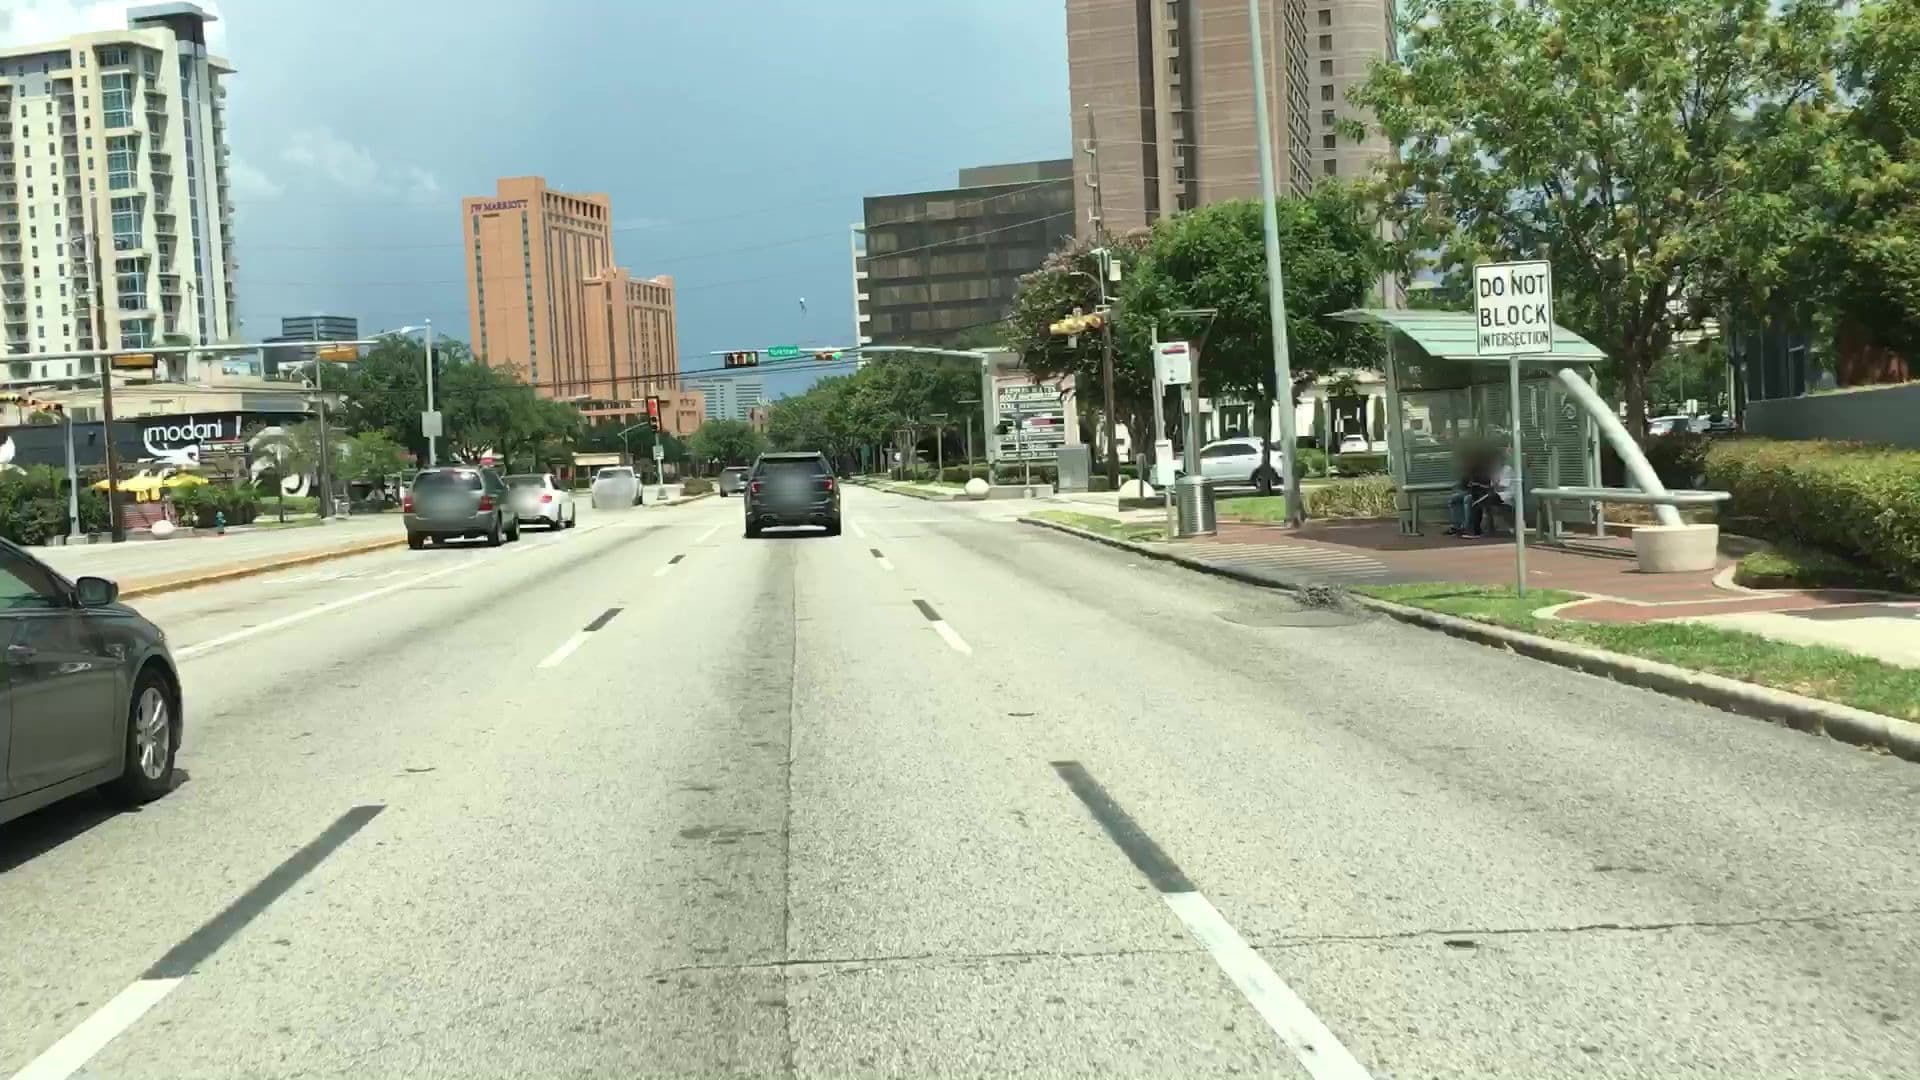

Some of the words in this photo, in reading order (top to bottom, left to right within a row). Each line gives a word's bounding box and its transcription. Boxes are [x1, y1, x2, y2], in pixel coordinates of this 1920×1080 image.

[471, 203, 482, 214] JW
[483, 199, 529, 210] MARRIOTT
[1480, 277, 1504, 298] DO
[1511, 274, 1545, 296] NOT
[1480, 304, 1547, 327] BLOCK
[1480, 331, 1549, 348] INTERSECTION
[148, 416, 222, 442] modani
